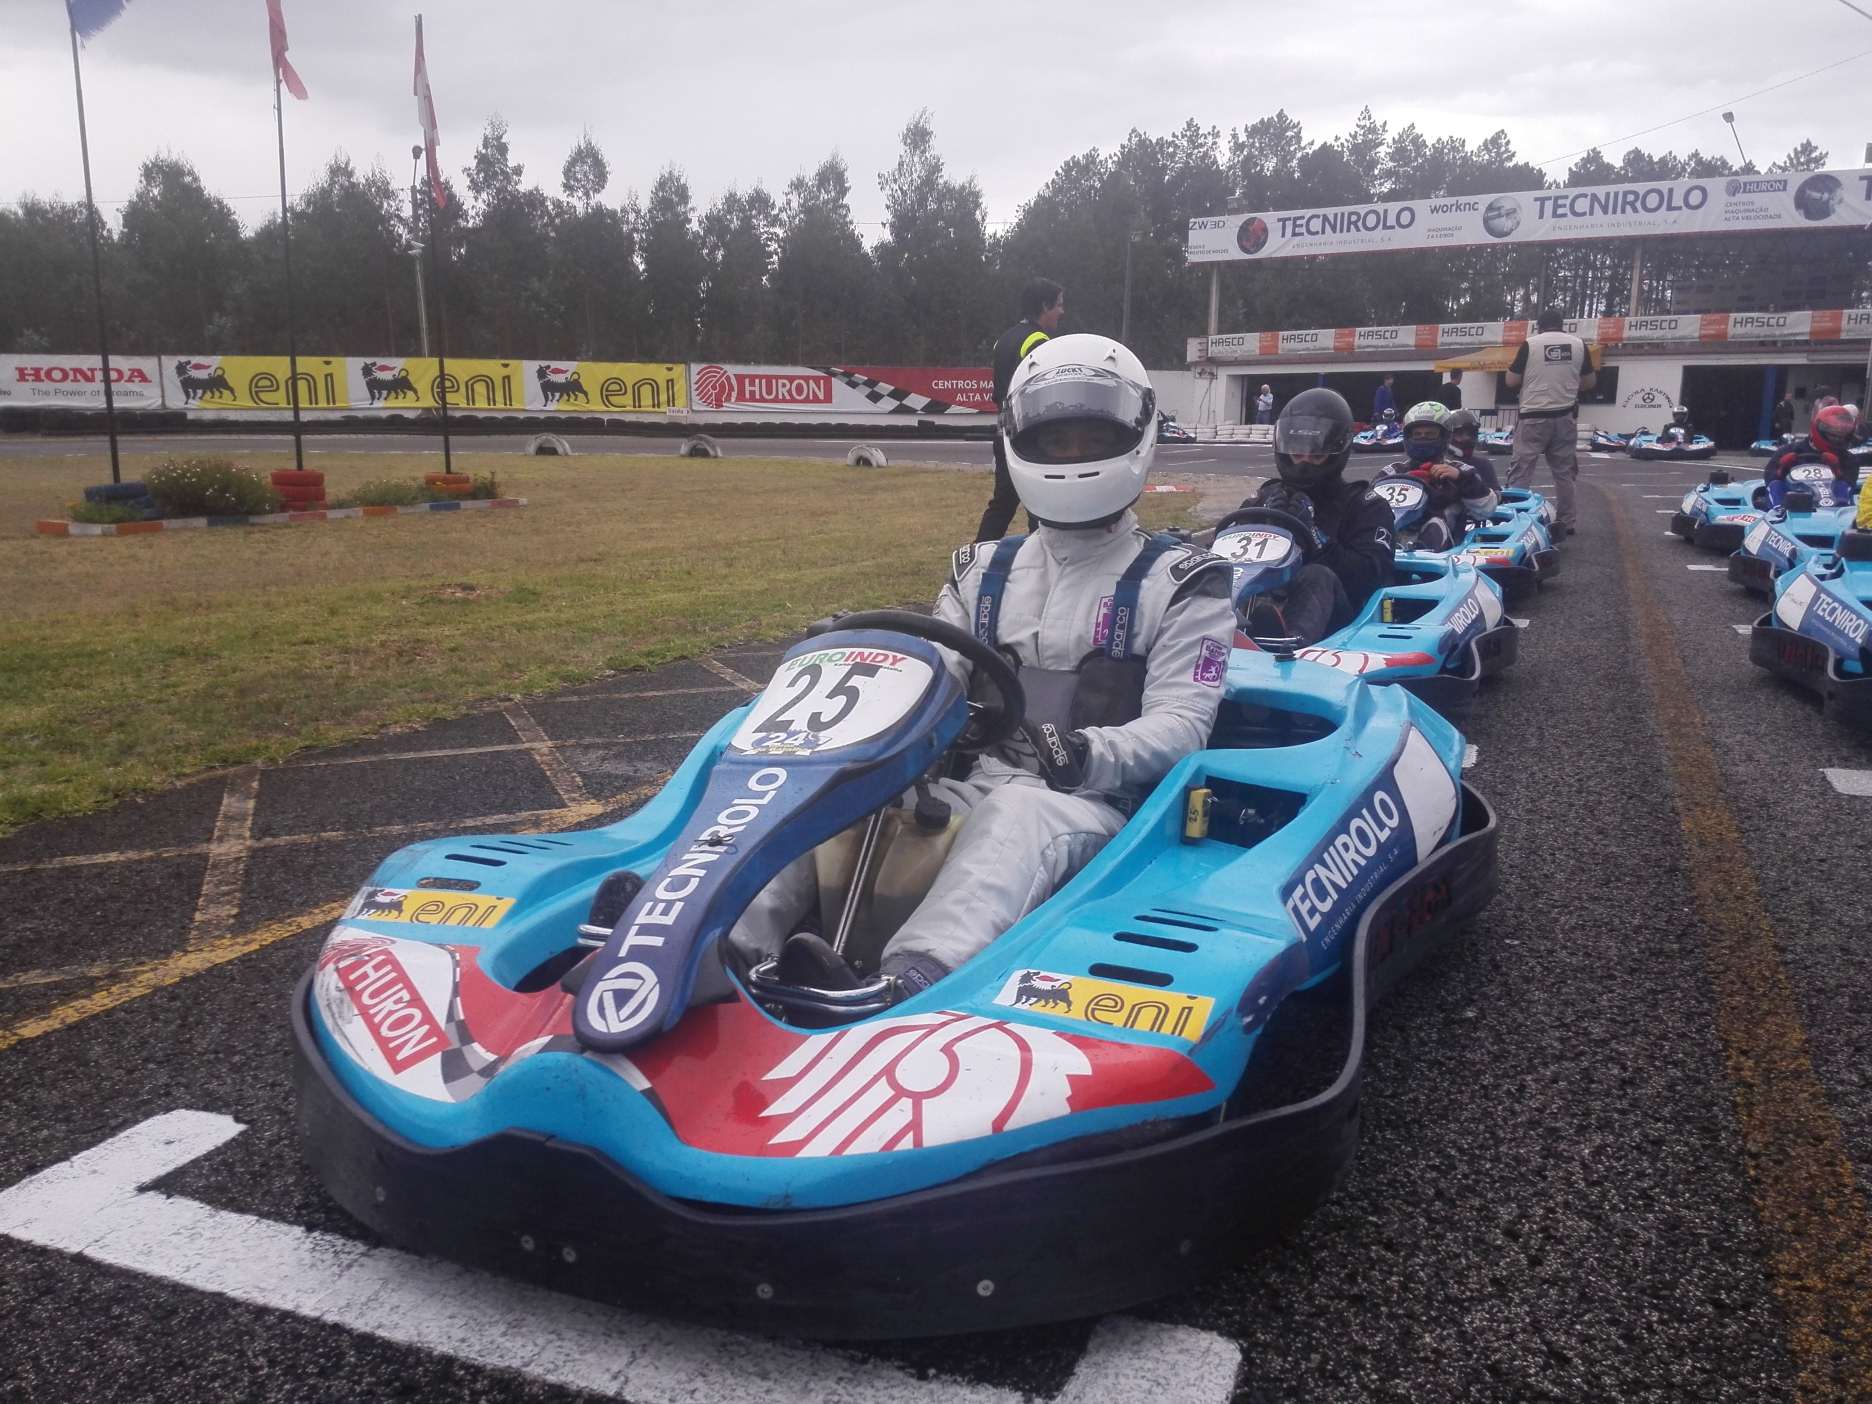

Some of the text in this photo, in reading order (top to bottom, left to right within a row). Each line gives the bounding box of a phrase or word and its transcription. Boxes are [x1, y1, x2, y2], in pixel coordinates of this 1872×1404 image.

[1746, 181, 1784, 192] HURON
[1534, 185, 1708, 220] TECNIROLO
[1277, 206, 1416, 239] TECNIROLO
[1441, 326, 1485, 338] HASCO
[1628, 319, 1678, 331] HASCO
[1732, 316, 1787, 329] HASCO
[1210, 336, 1245, 347] HASCO
[1282, 333, 1319, 344] HASCO
[1358, 329, 1399, 341] HASCO
[15, 367, 152, 383] HONDA
[248, 360, 337, 406] eni
[430, 363, 512, 407] eni
[932, 380, 978, 389] CENTROS
[31, 388, 50, 397] The
[54, 388, 87, 397] Power
[104, 388, 144, 397] reams
[600, 366, 675, 409] eni
[744, 378, 825, 401] HURON
[956, 393, 982, 402] ALTA
[1802, 468, 1824, 480] 28
[1386, 487, 1408, 503] 35
[1230, 536, 1269, 559] 31
[1813, 593, 1869, 645] TECNIROL
[752, 662, 881, 733] 25
[617, 767, 788, 958] TECNIROLO
[1285, 790, 1400, 943] TECNIROLO
[409, 896, 505, 927] eni
[348, 955, 438, 1061] HURON
[1084, 993, 1199, 1037] eni
